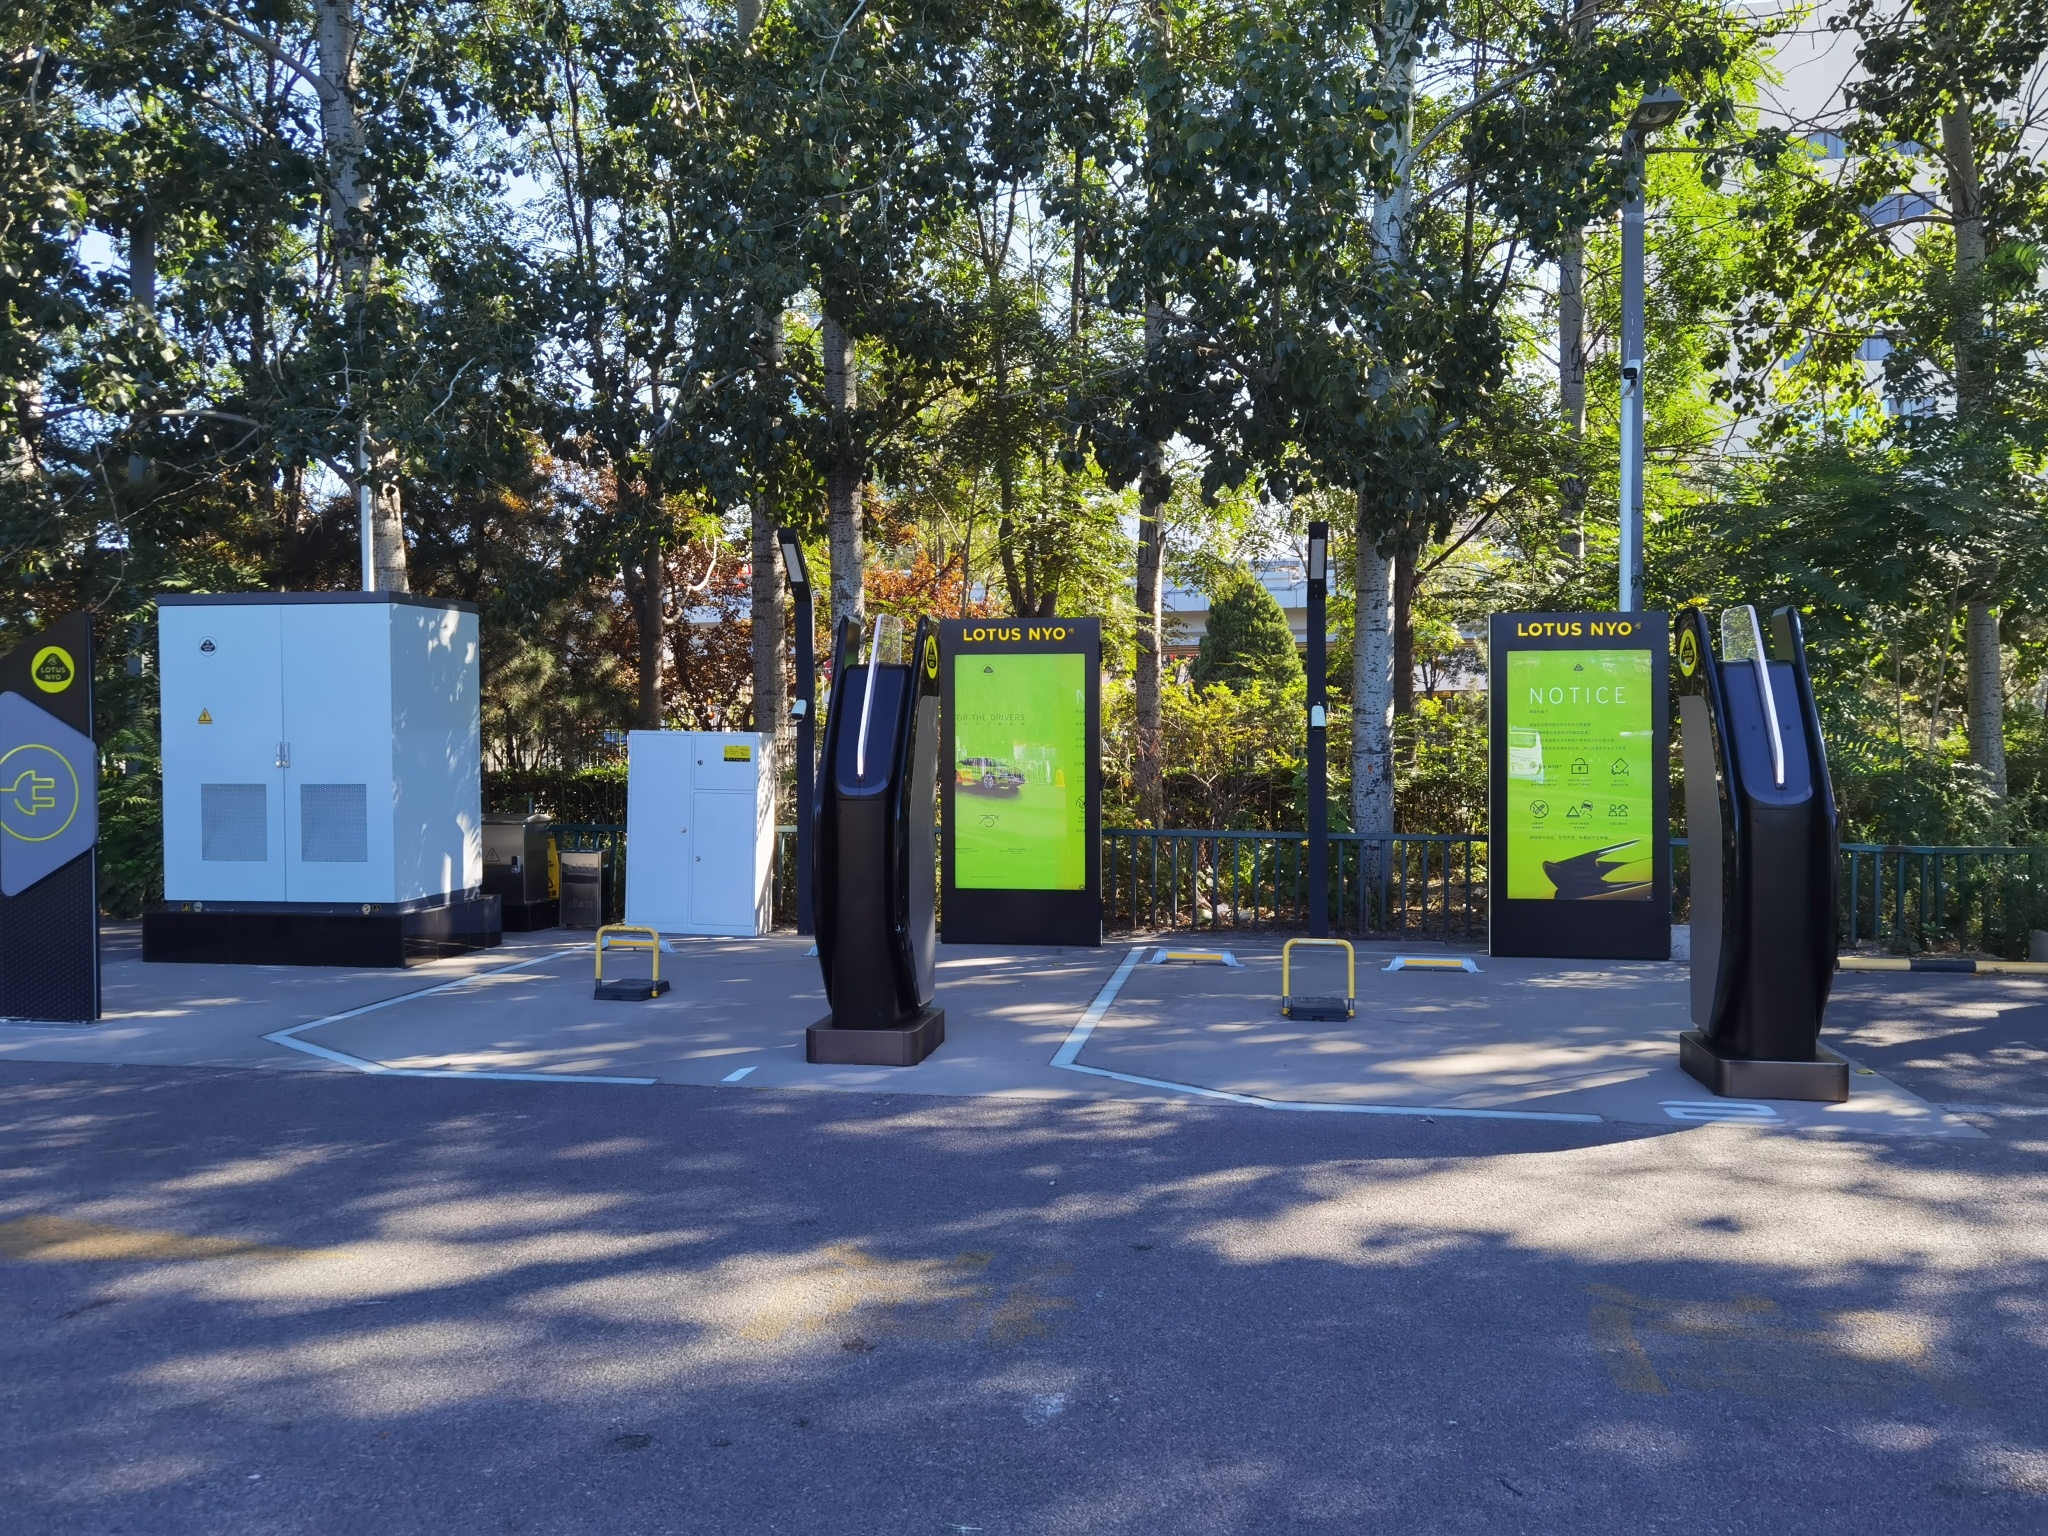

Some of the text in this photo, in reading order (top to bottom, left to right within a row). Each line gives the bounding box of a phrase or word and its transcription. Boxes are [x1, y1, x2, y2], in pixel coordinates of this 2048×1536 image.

[963, 627, 1066, 641] LOTUS NYO
[1517, 621, 1633, 637] LOTUS NYO
[1530, 686, 1626, 704] NOTICE
[991, 713, 1025, 721] DRIVERS
